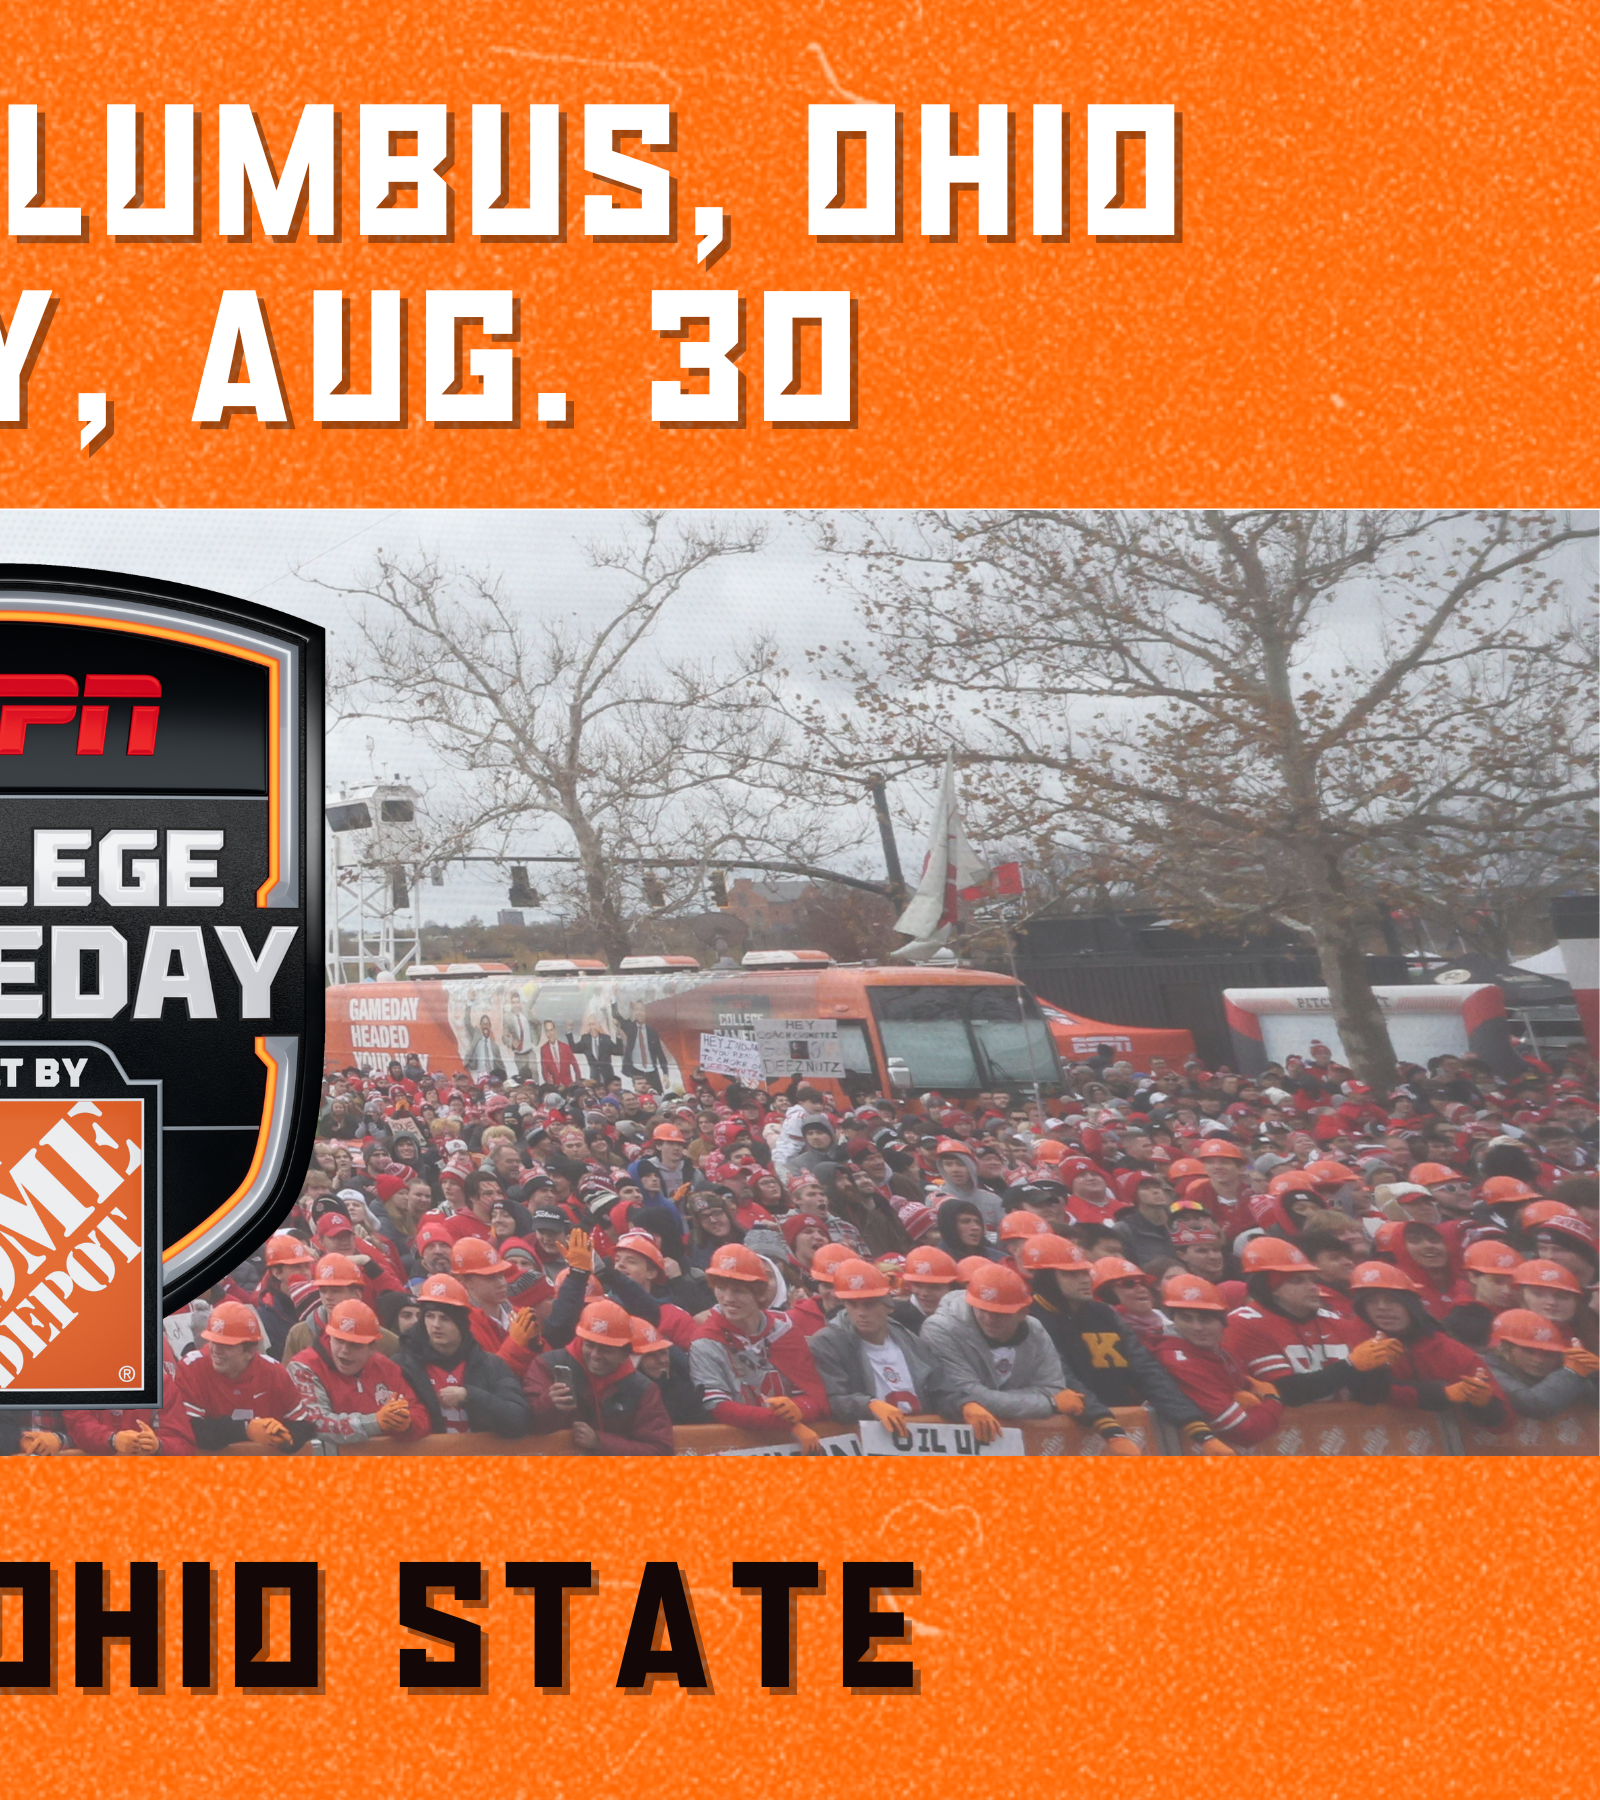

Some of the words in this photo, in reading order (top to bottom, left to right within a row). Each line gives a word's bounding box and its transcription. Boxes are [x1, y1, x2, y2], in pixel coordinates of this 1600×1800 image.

[349, 997, 419, 1021] GAMEDAY
[785, 1020, 815, 1030] HEY
[350, 1025, 410, 1049] HEADED
[703, 1034, 724, 1049] HEY
[1071, 1035, 1132, 1053] ESPN
[394, 1053, 429, 1074] WY
[701, 1054, 713, 1062] TO
[716, 1057, 748, 1067] CHOKE
[1081, 1332, 1128, 1368] K
